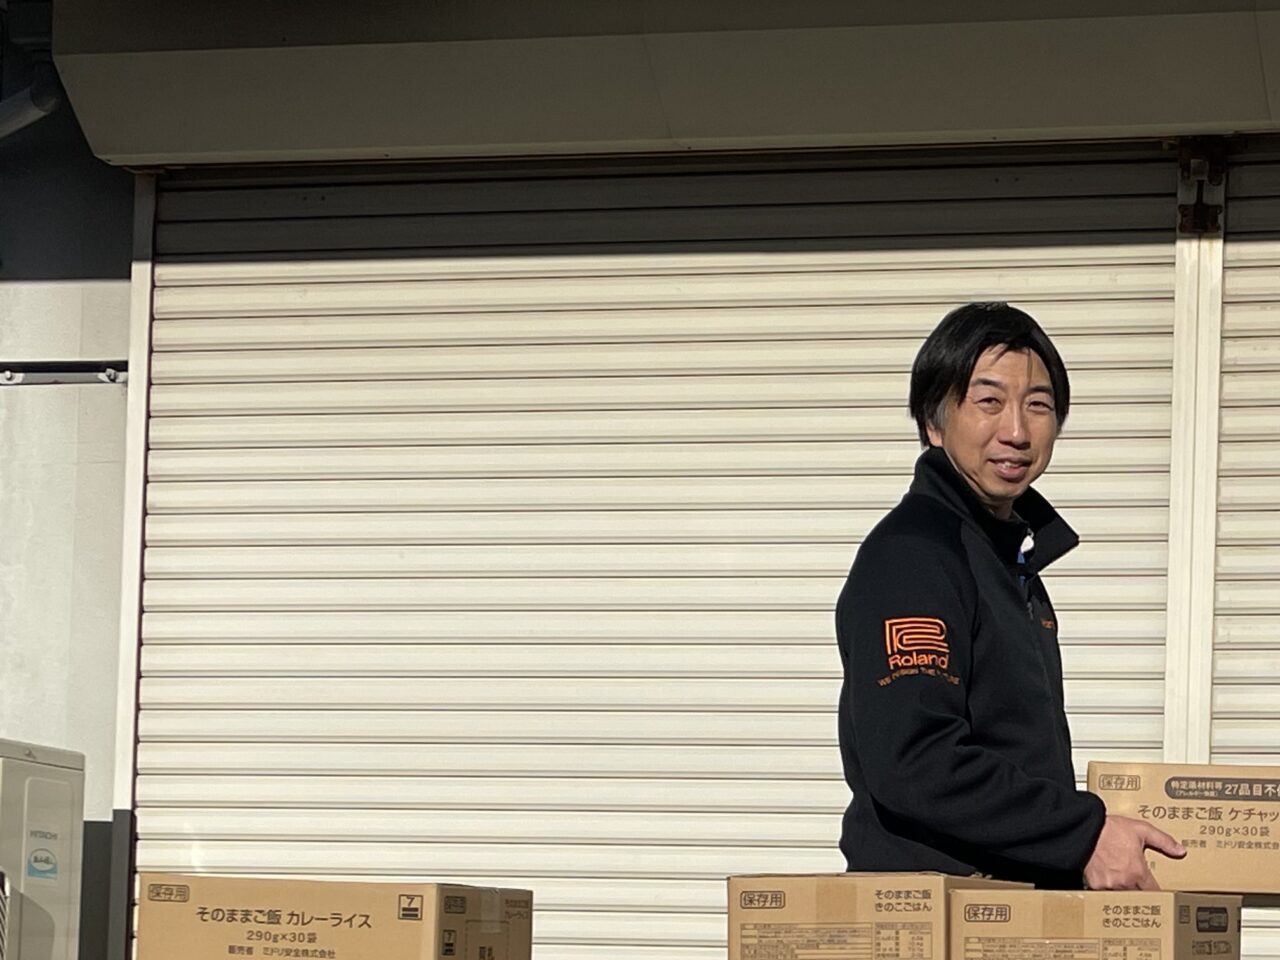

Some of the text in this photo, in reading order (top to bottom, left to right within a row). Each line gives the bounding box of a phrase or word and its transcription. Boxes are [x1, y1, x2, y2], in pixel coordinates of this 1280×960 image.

[888, 652, 948, 670] Roland
[1100, 776, 1138, 790] 保存用
[1138, 804, 1222, 822] そのままご飯
[742, 893, 782, 908] 保存用
[874, 888, 932, 900] そのままご飯
[874, 902, 933, 913] きのこごはん
[966, 906, 1008, 921] 保存用
[1102, 904, 1162, 916] そのままご飯
[196, 906, 372, 930] そのままご飯 カレーライス
[1102, 918, 1162, 929] きのこごはん
